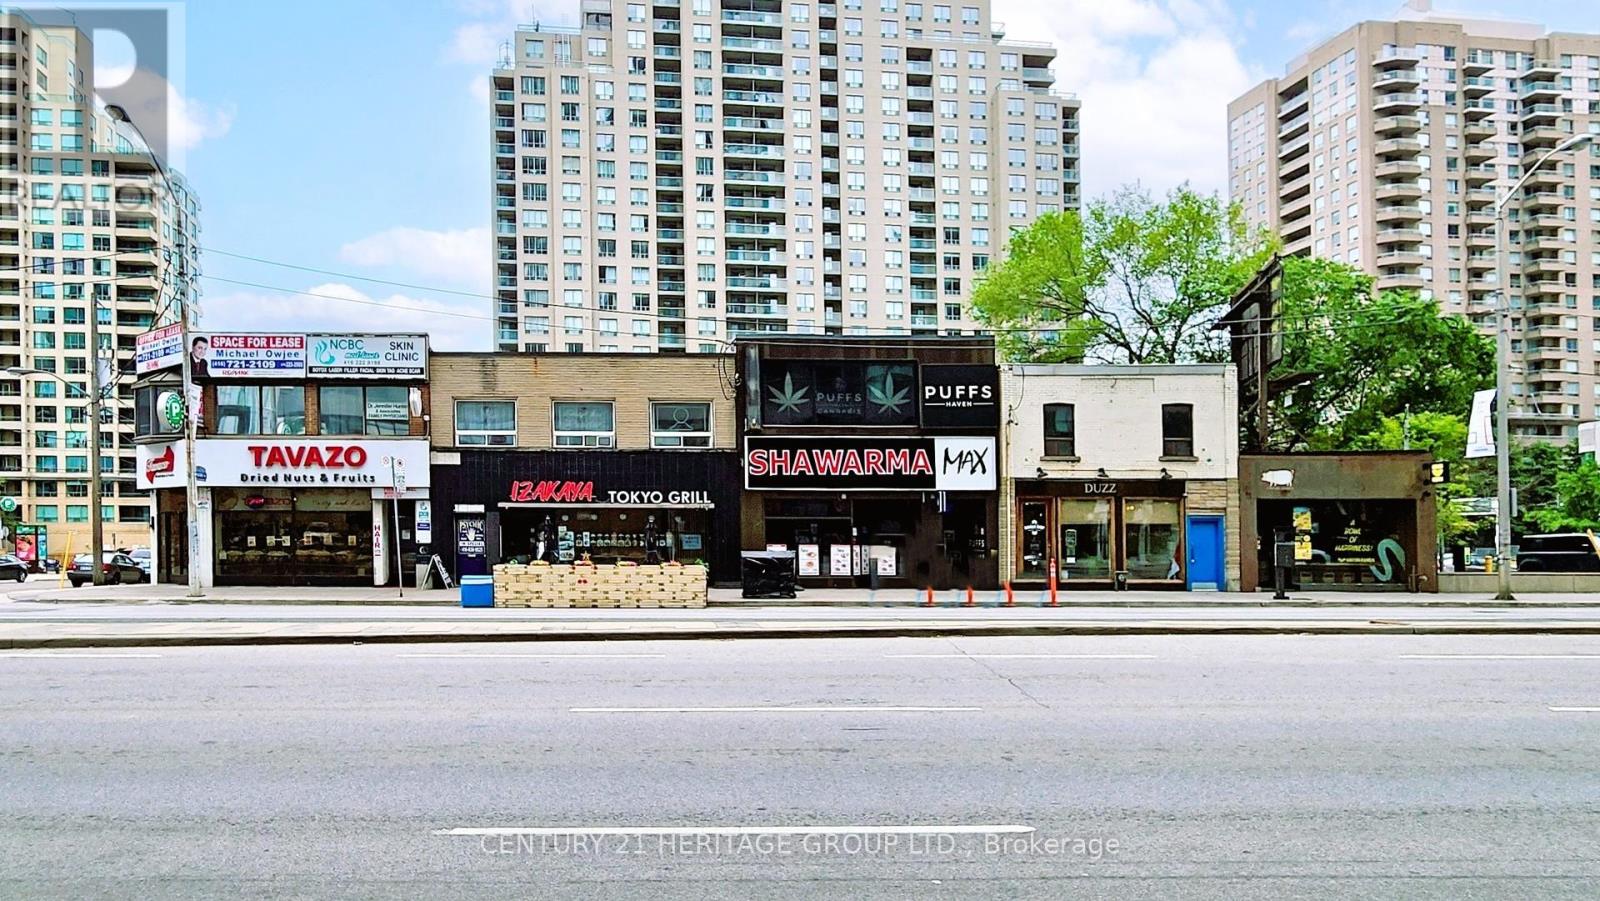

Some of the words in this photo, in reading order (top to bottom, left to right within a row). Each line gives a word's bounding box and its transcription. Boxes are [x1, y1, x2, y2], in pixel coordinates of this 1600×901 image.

[212, 336, 246, 348] SPACE
[246, 336, 267, 348] FOR
[269, 336, 301, 348] LEASE
[329, 339, 364, 350] NCBC
[389, 341, 414, 351] SKIN
[215, 349, 259, 358] Michael
[265, 349, 300, 360] Owjee
[384, 352, 420, 362] CLINIC
[226, 360, 276, 369] 721-2109
[816, 392, 862, 402] PUFFS
[924, 385, 993, 400] PUFFS
[945, 400, 973, 408] HAVEN
[247, 446, 368, 468] TAVAZO
[748, 448, 934, 475] SHAWARMA
[942, 446, 989, 475] MAX
[240, 473, 279, 483] Dried
[283, 473, 315, 483] Nuts
[319, 473, 329, 483] &
[333, 473, 376, 483] Fruits
[511, 480, 594, 502] IZAKAYA
[607, 490, 664, 504] TOKYO
[668, 490, 712, 504] GRILL
[1084, 483, 1118, 494] DUZZ
